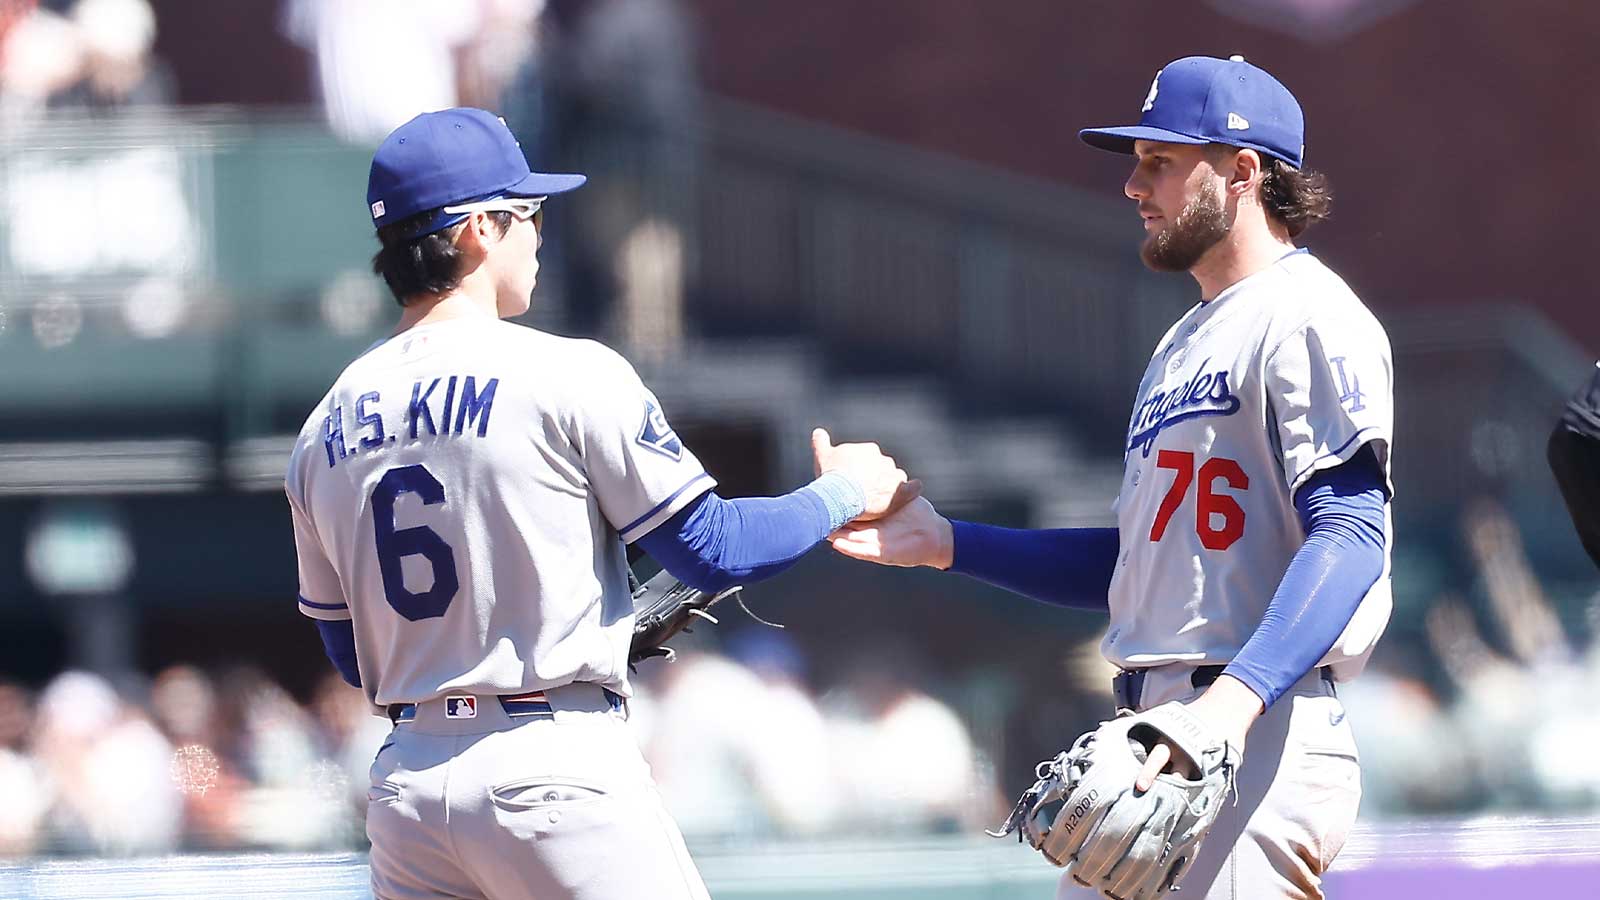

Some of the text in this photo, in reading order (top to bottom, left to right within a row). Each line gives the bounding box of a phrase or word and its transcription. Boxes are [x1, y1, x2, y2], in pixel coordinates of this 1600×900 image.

[323, 376, 499, 468] H.S. KIM
[371, 464, 460, 622] 6
[1150, 449, 1249, 551] 76
[1065, 789, 1098, 834] A2000
